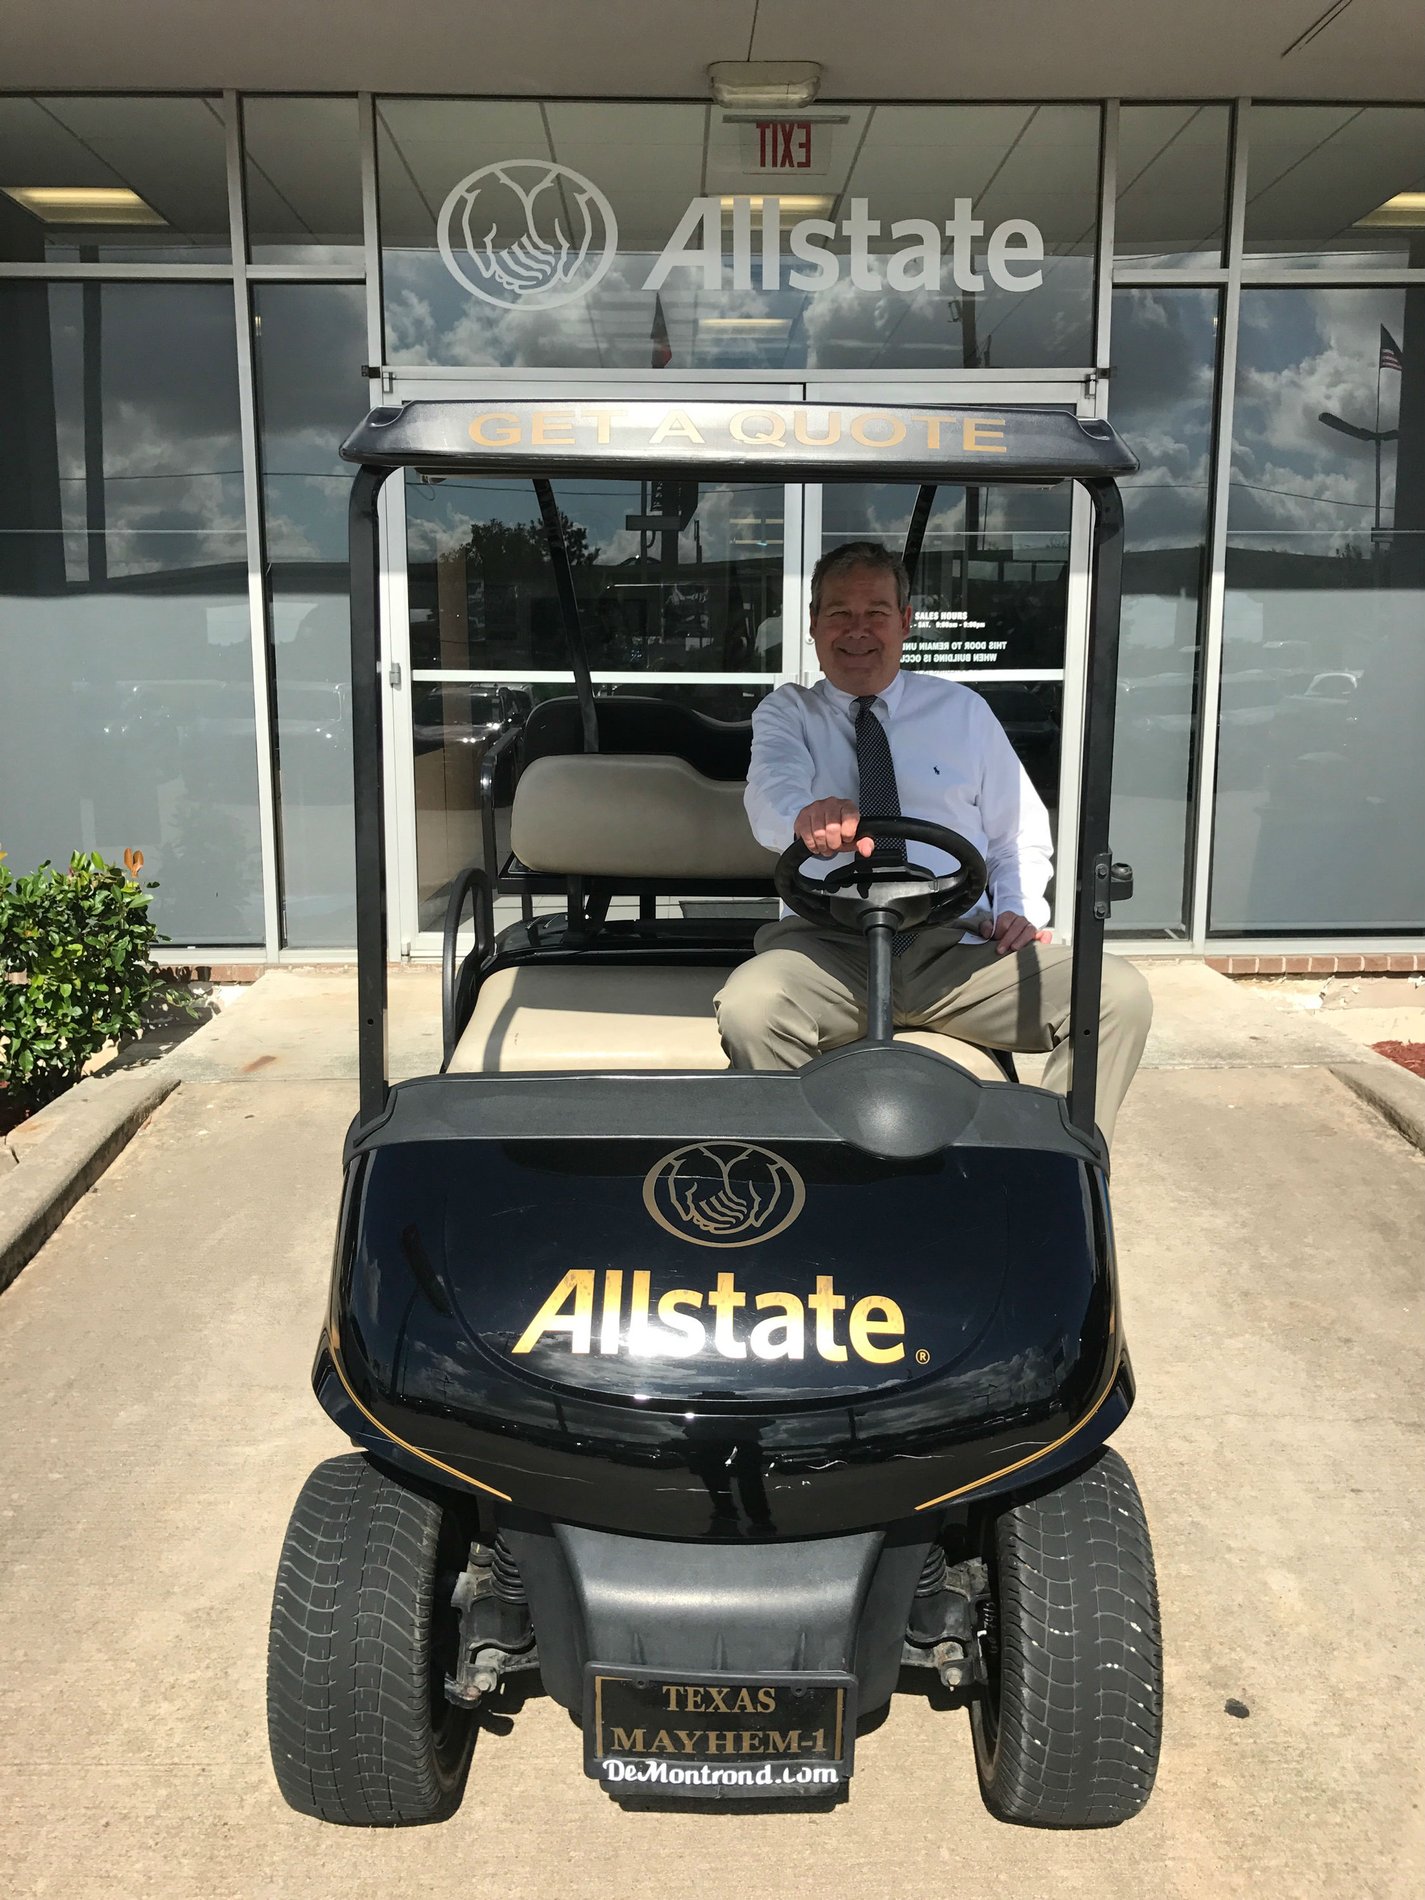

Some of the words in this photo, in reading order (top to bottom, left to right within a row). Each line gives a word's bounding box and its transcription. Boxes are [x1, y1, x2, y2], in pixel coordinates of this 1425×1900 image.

[641, 197, 1044, 292] Allstate
[468, 409, 628, 446] GET
[648, 409, 706, 444] A
[729, 409, 1007, 453] QUOTE
[914, 611, 939, 620] SALES
[940, 611, 968, 620] HOURS
[512, 1269, 905, 1363] Allstate
[662, 1685, 776, 1713] TEXAS
[609, 1727, 828, 1754] MAYHEM-1
[602, 1759, 839, 1785] DeMontrond.com
